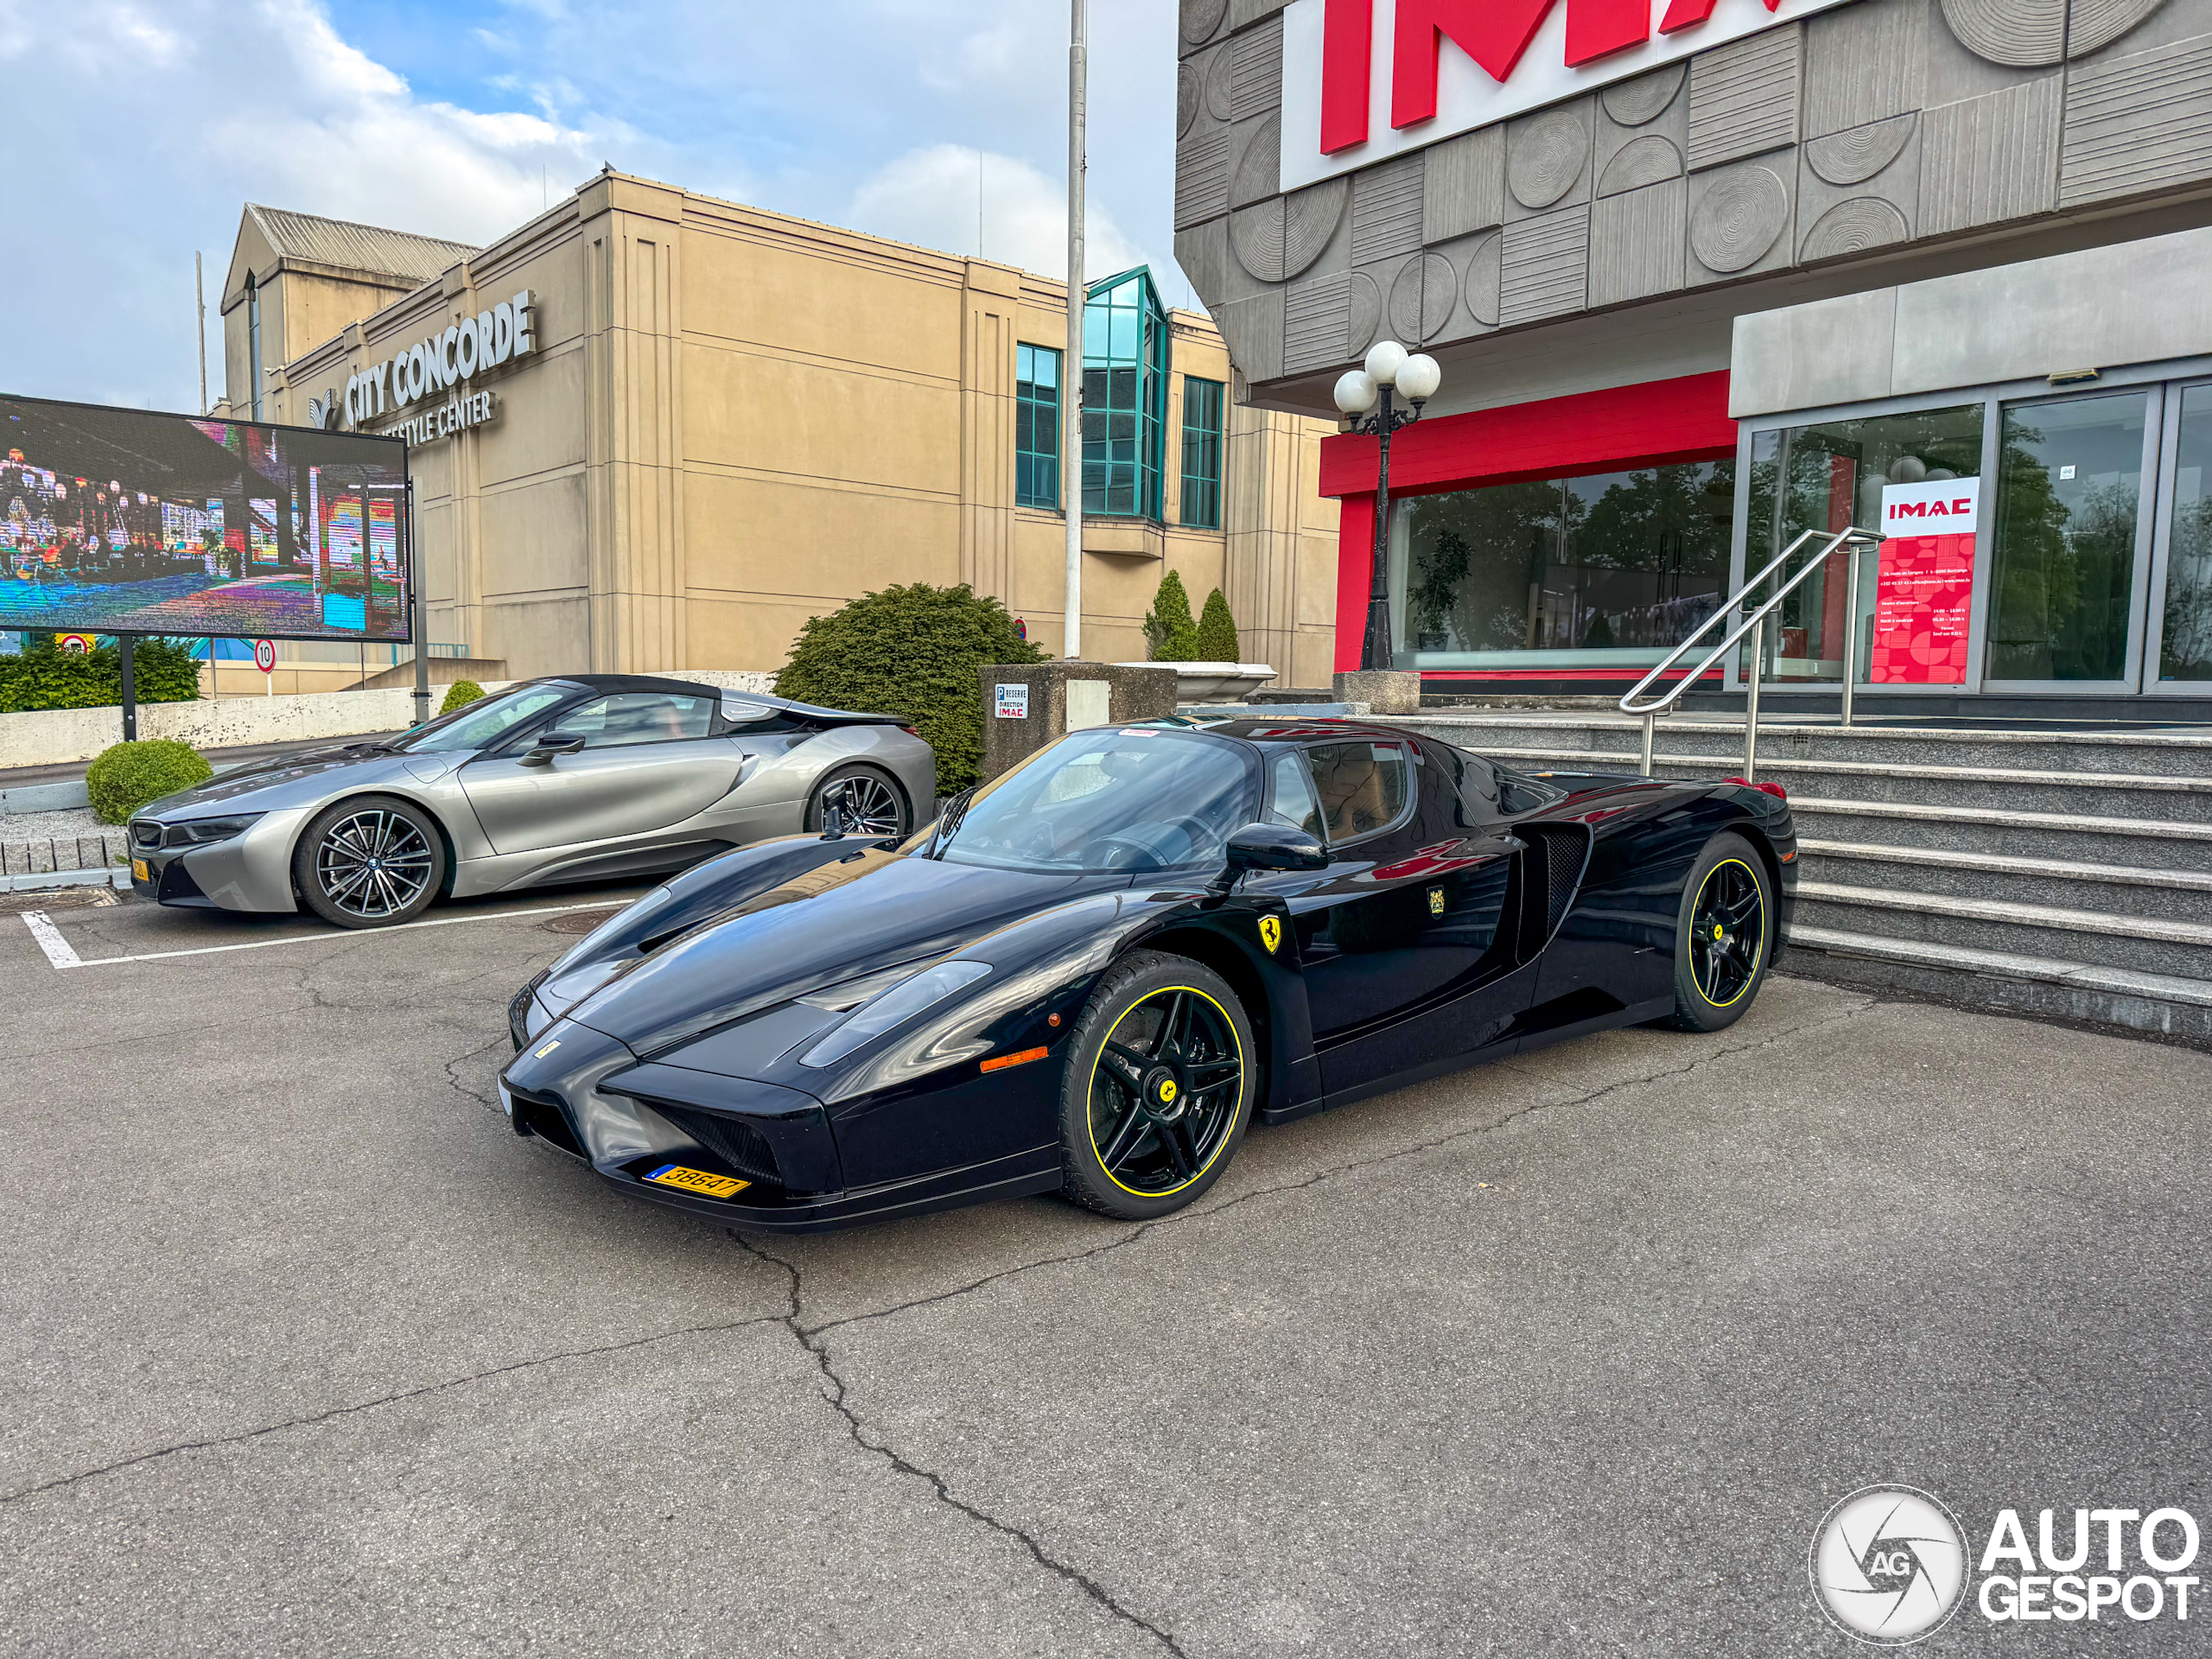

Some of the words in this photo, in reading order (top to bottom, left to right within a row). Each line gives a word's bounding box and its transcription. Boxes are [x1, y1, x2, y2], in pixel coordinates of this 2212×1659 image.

[345, 360, 392, 426] CITY
[393, 289, 535, 407] CONCORDE
[437, 390, 493, 436] CENTER
[1889, 498, 1971, 520] IMAC
[259, 646, 270, 662] 10
[998, 688, 1003, 699] P
[1005, 690, 1027, 698] RESERVE
[664, 1169, 741, 1192] 38647
